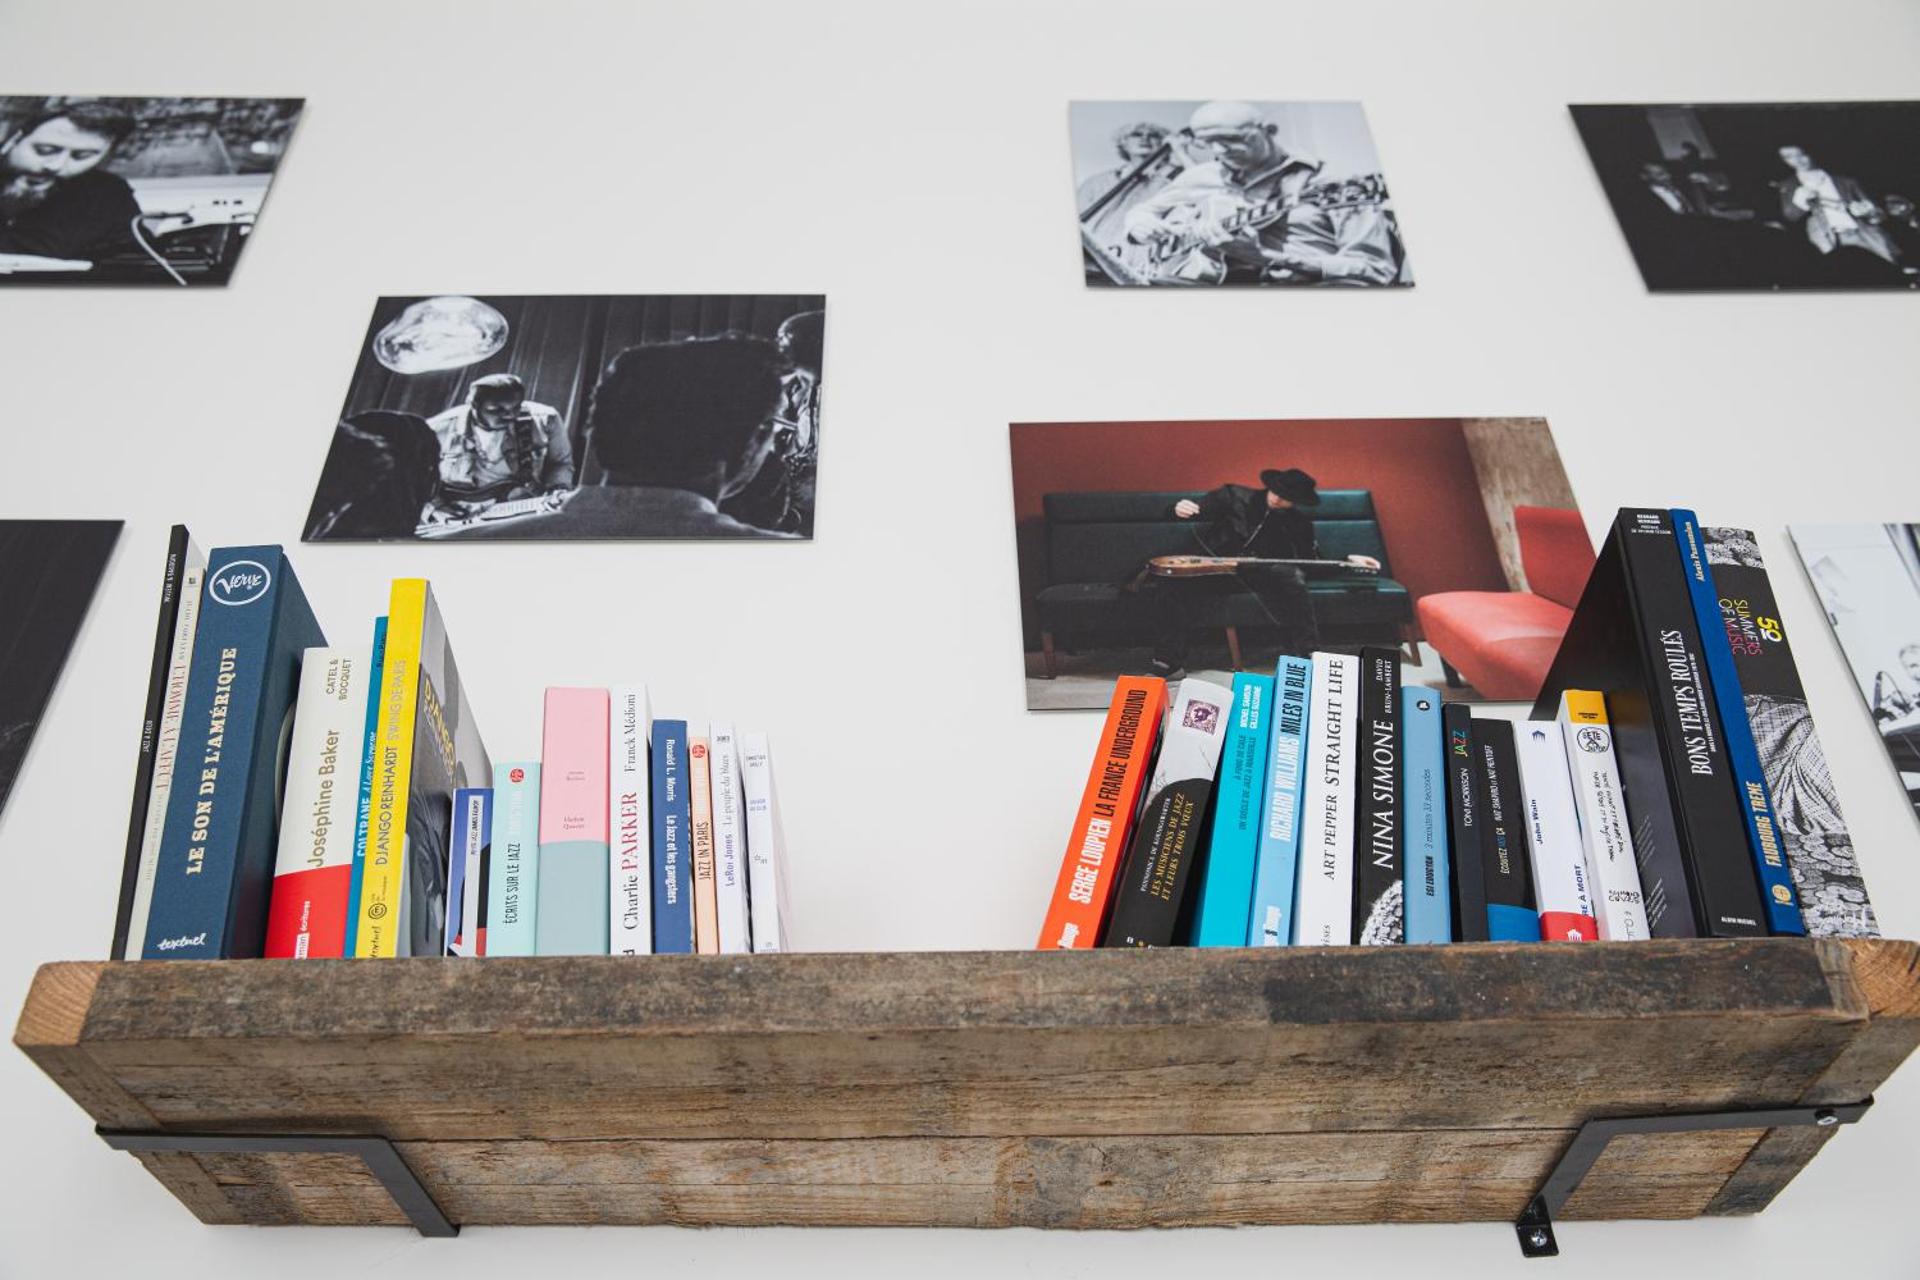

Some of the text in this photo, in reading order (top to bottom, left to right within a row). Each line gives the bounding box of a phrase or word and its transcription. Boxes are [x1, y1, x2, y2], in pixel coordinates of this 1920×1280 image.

[215, 573, 262, 595] Verve
[1691, 559, 1705, 582] Alexis
[1719, 599, 1746, 656] OF MUSIC
[1734, 600, 1764, 655] SUMMERS
[326, 657, 338, 695] CATEL &
[339, 658, 351, 700] BOCQUET
[1376, 658, 1384, 682] DAVID
[1384, 660, 1393, 714] BRUN-LAMBERT
[1660, 629, 1714, 777] BONS TEMPS ROULÉS
[387, 705, 402, 741] SWING
[186, 647, 238, 876] LE SON DE L'AMÉRIQUE
[666, 739, 676, 765] Ronald
[1270, 663, 1307, 842] RICHARD WILLIAMS MILES IN BLUE
[381, 746, 398, 810] REINHARDT
[667, 767, 675, 775] L.
[1323, 659, 1343, 880] ART PEPPER STRAIGHT LIFE
[1423, 768, 1431, 801] secondes
[1453, 729, 1472, 827] TONI MORRISON JAZZ
[307, 730, 341, 868] Joséphine Baker
[666, 777, 676, 801] Morris
[1068, 689, 1148, 904] SERGE LOUPIEN LA FRANCE UNDERGROUND
[1372, 719, 1394, 870] NINA SIMONE
[622, 693, 638, 930] Charlie PARKER Franck Médioni
[667, 815, 677, 825] Le
[1531, 799, 1544, 845] John Wain
[375, 809, 392, 866] DJANGO
[697, 822, 709, 845] PARIS
[724, 834, 734, 859] Jones
[1151, 793, 1185, 896] LES MUSICIENS DE JAZZ
[1173, 829, 1187, 856] TROIS
[1755, 815, 1782, 868] FAUBOURG
[508, 842, 521, 861] JAZZ
[667, 852, 677, 864] les
[698, 845, 710, 856] IN
[507, 875, 519, 892] SUR
[508, 863, 519, 873] LE
[699, 857, 711, 880] JAZZ
[724, 861, 735, 886] LeRoi
[1164, 857, 1180, 888] LEURS
[1574, 864, 1584, 892] MORT
[665, 865, 677, 904] gangsters
[1161, 887, 1170, 901] ET
[1579, 893, 1587, 902] À
[504, 893, 520, 924] ÉCRITS
